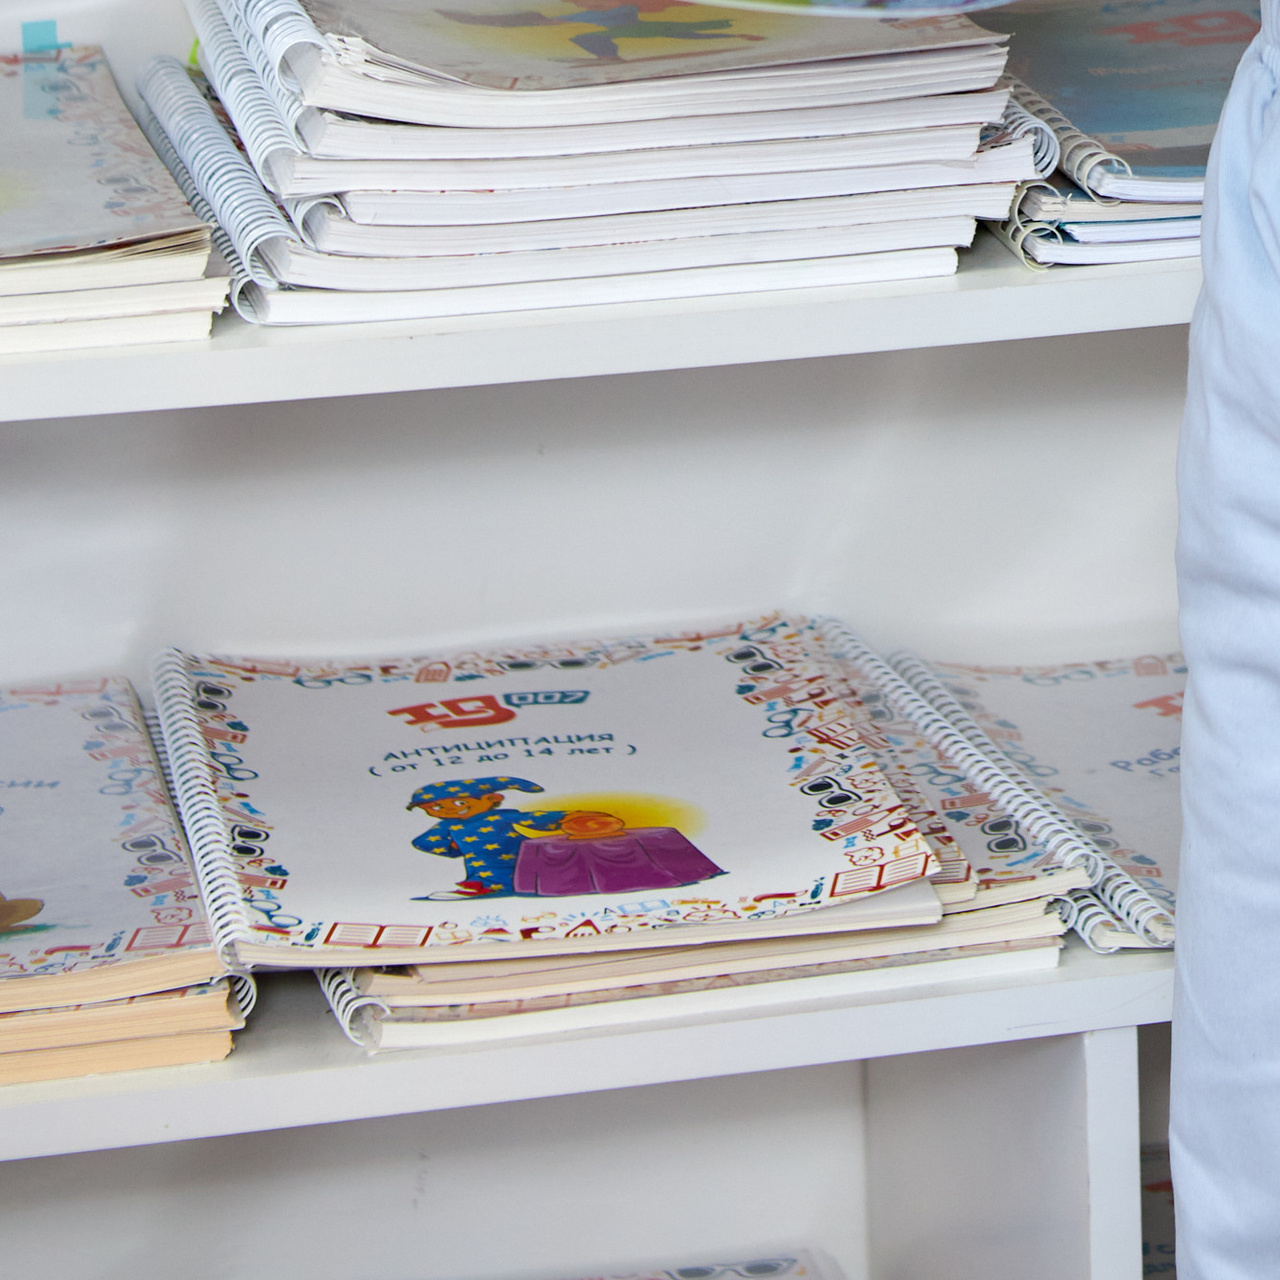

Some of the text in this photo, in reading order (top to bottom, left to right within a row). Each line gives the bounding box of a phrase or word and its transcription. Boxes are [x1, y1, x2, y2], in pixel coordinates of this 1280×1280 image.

[387, 691, 588, 730] IQ 007
[383, 732, 615, 762] АНТИЦИПАЦИЯ
[435, 755, 463, 767] 12
[476, 752, 509, 763] до
[524, 747, 554, 758] 14
